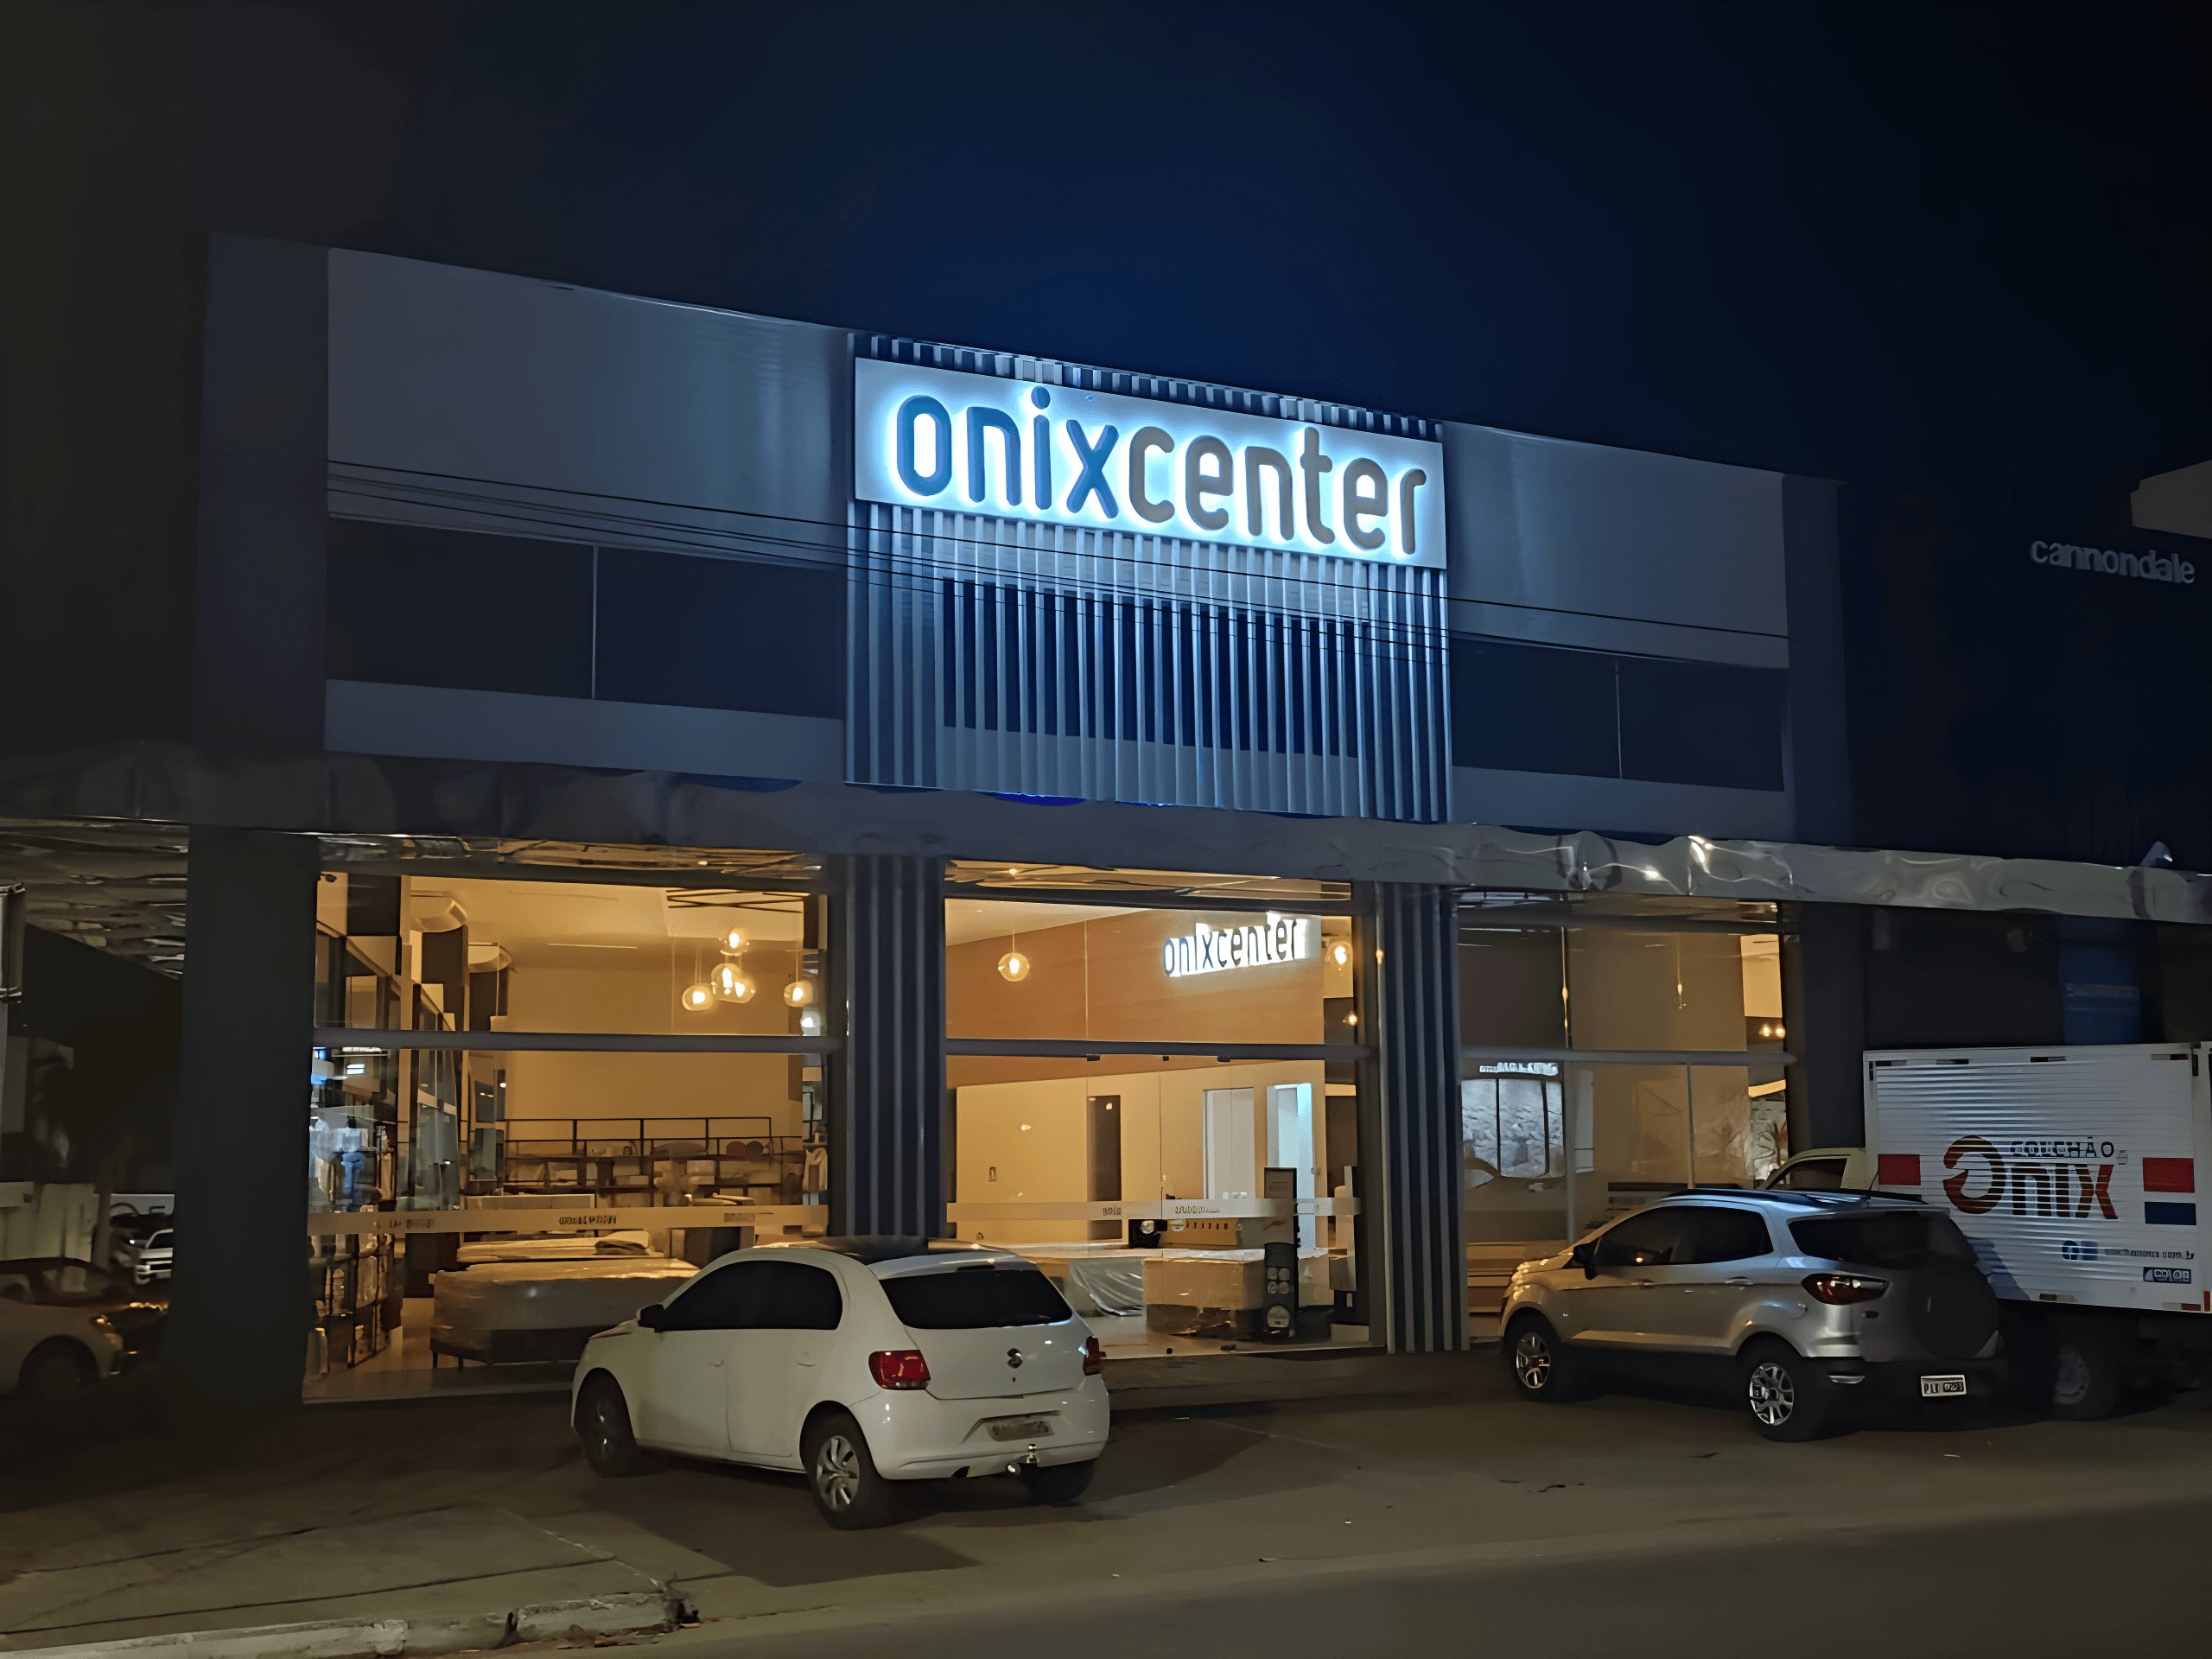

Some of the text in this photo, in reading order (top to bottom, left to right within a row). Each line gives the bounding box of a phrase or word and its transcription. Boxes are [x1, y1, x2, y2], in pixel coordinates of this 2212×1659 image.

[897, 386, 1427, 555] onixcenter
[2031, 540, 2195, 584] cannondale
[1163, 919, 1298, 976] onixcenter
